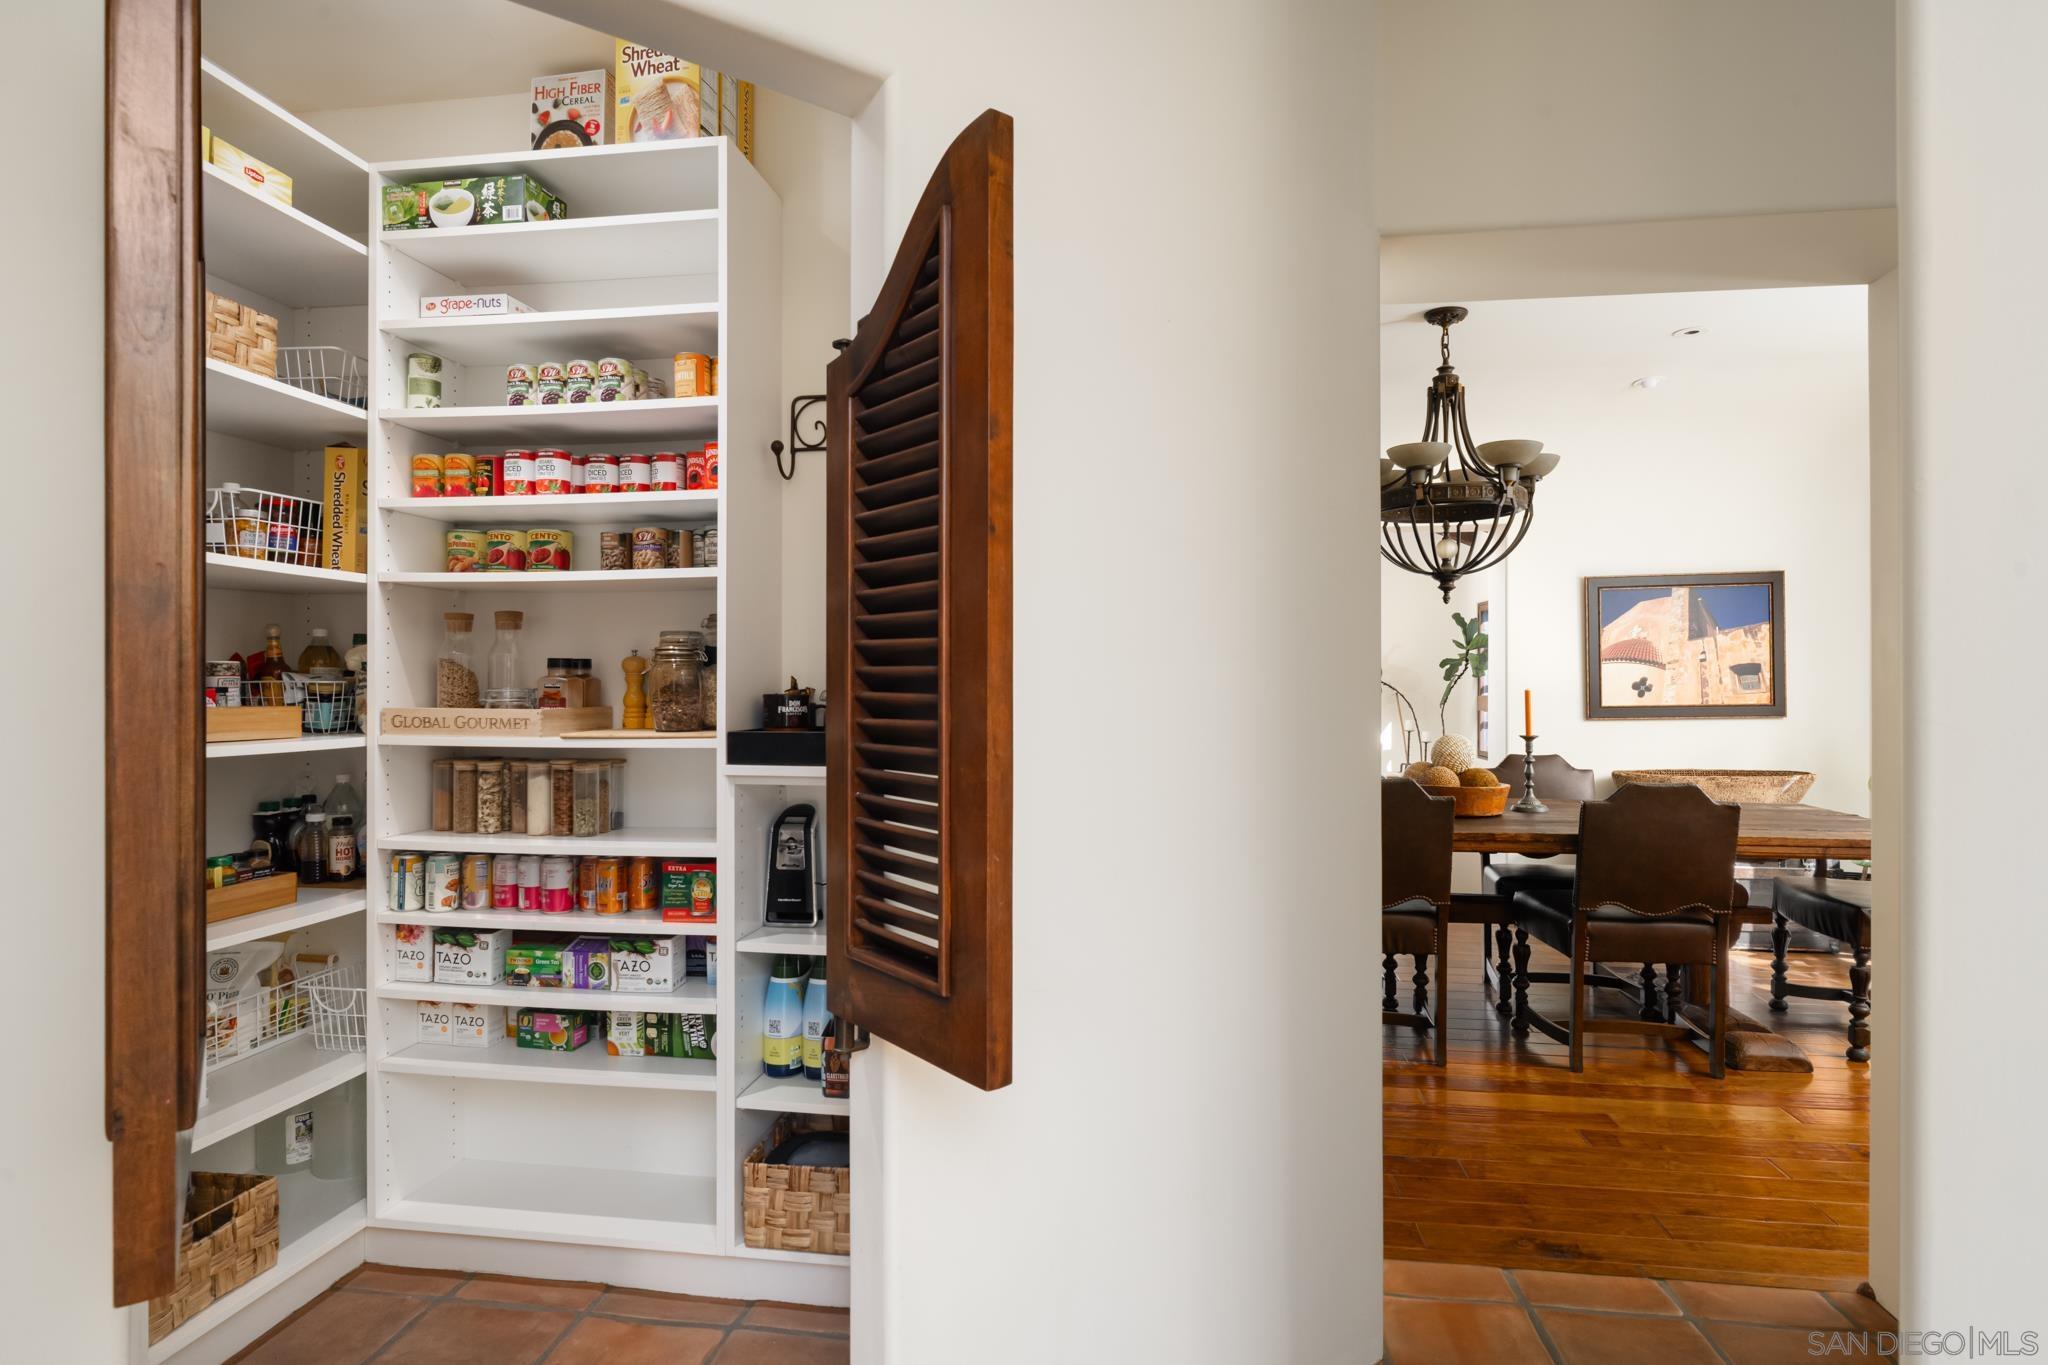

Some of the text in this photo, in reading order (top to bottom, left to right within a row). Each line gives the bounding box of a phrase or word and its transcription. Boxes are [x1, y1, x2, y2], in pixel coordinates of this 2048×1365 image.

[631, 57, 681, 78] Wheat
[535, 81, 601, 101] HIGH FIBER
[561, 95, 596, 106] CEREAL
[440, 297, 502, 314] grape-nuts
[333, 471, 346, 528] Shredded
[331, 528, 344, 571] Wheat
[391, 714, 530, 731] GLOBAL GOURMET
[397, 950, 425, 961] TAZO
[436, 951, 472, 966] TAZO
[420, 1012, 450, 1025] TAZO
[455, 1016, 484, 1028] TAZO
